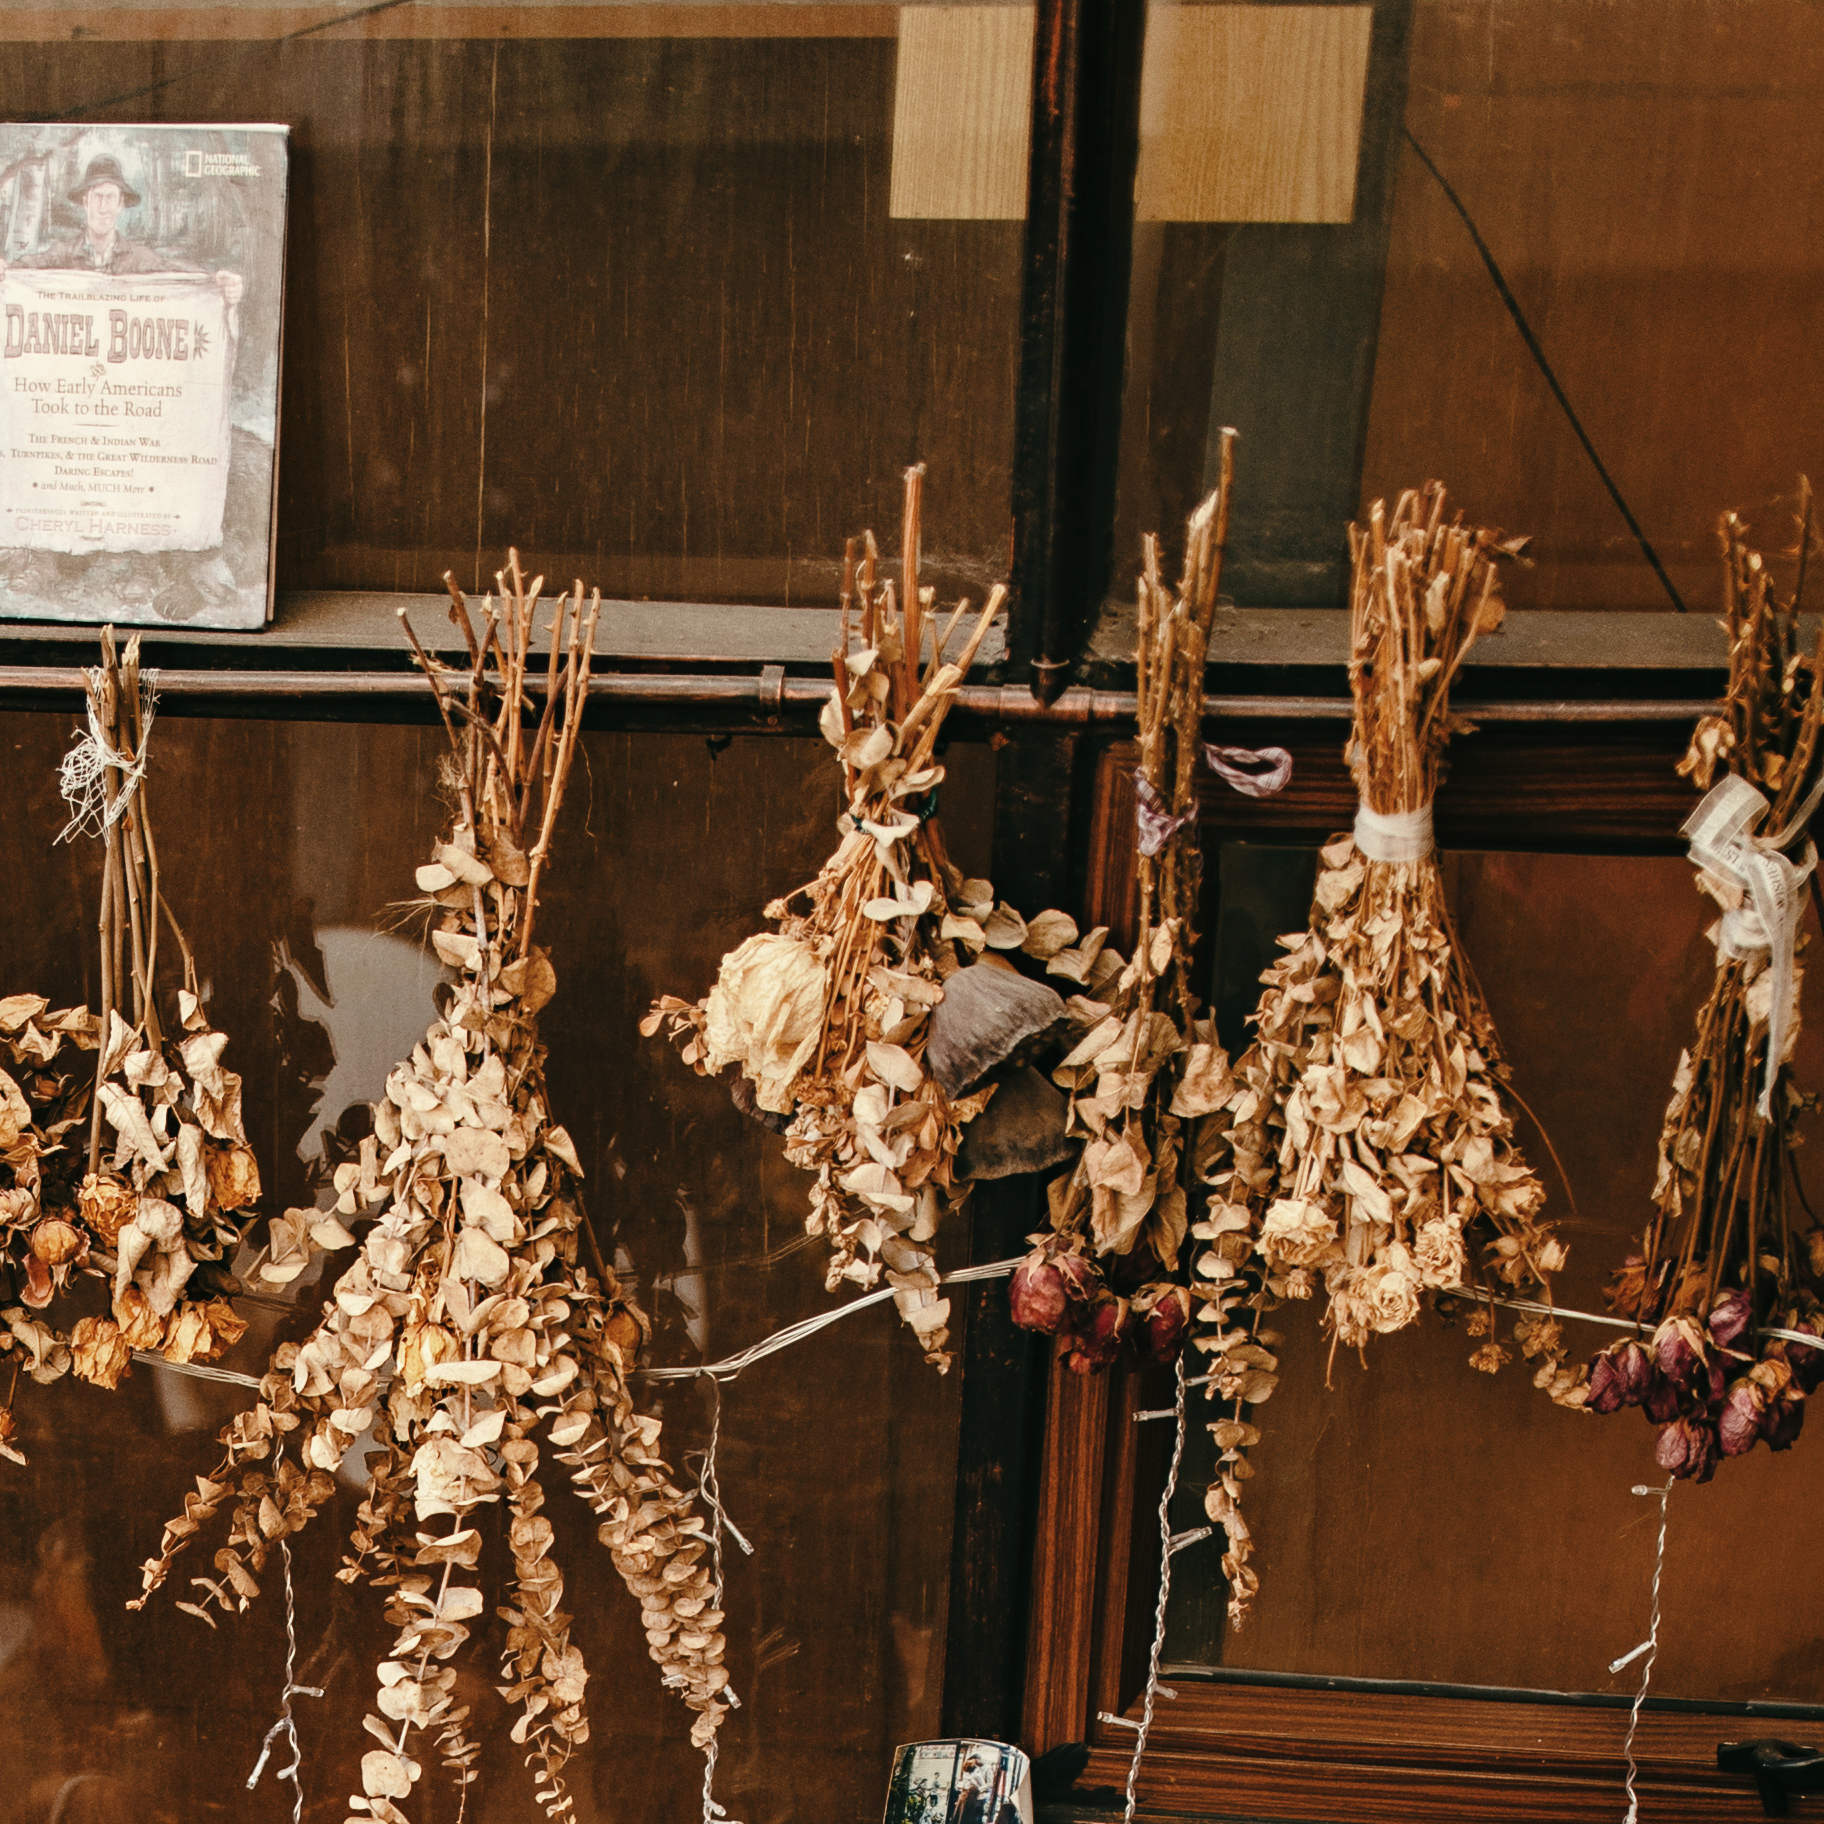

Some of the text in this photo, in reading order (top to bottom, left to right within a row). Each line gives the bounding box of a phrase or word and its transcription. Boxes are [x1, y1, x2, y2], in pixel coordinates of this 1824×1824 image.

[205, 153, 249, 165] NATIONAL
[204, 164, 261, 177] GEOGRAPHIC
[37, 291, 166, 303] THE TRAILBLAZING LIFE OF
[4, 304, 189, 364] DANIEL BOONE
[14, 377, 182, 398] How Early Americans
[31, 398, 162, 418] Took to the Road
[28, 433, 161, 447] THE FRENCH & INDIAN WAR
[10, 448, 63, 461] TURNPIKES,
[65, 450, 74, 460] &
[77, 452, 94, 461] THE
[97, 452, 126, 462] GREAT
[130, 452, 189, 464] WILDERNESS
[191, 455, 218, 466] ROAD
[54, 466, 134, 477] DARING ESCAPES!
[41, 481, 145, 494] and Much, MUCH More
[15, 515, 172, 536] CHERYL HARNESS
